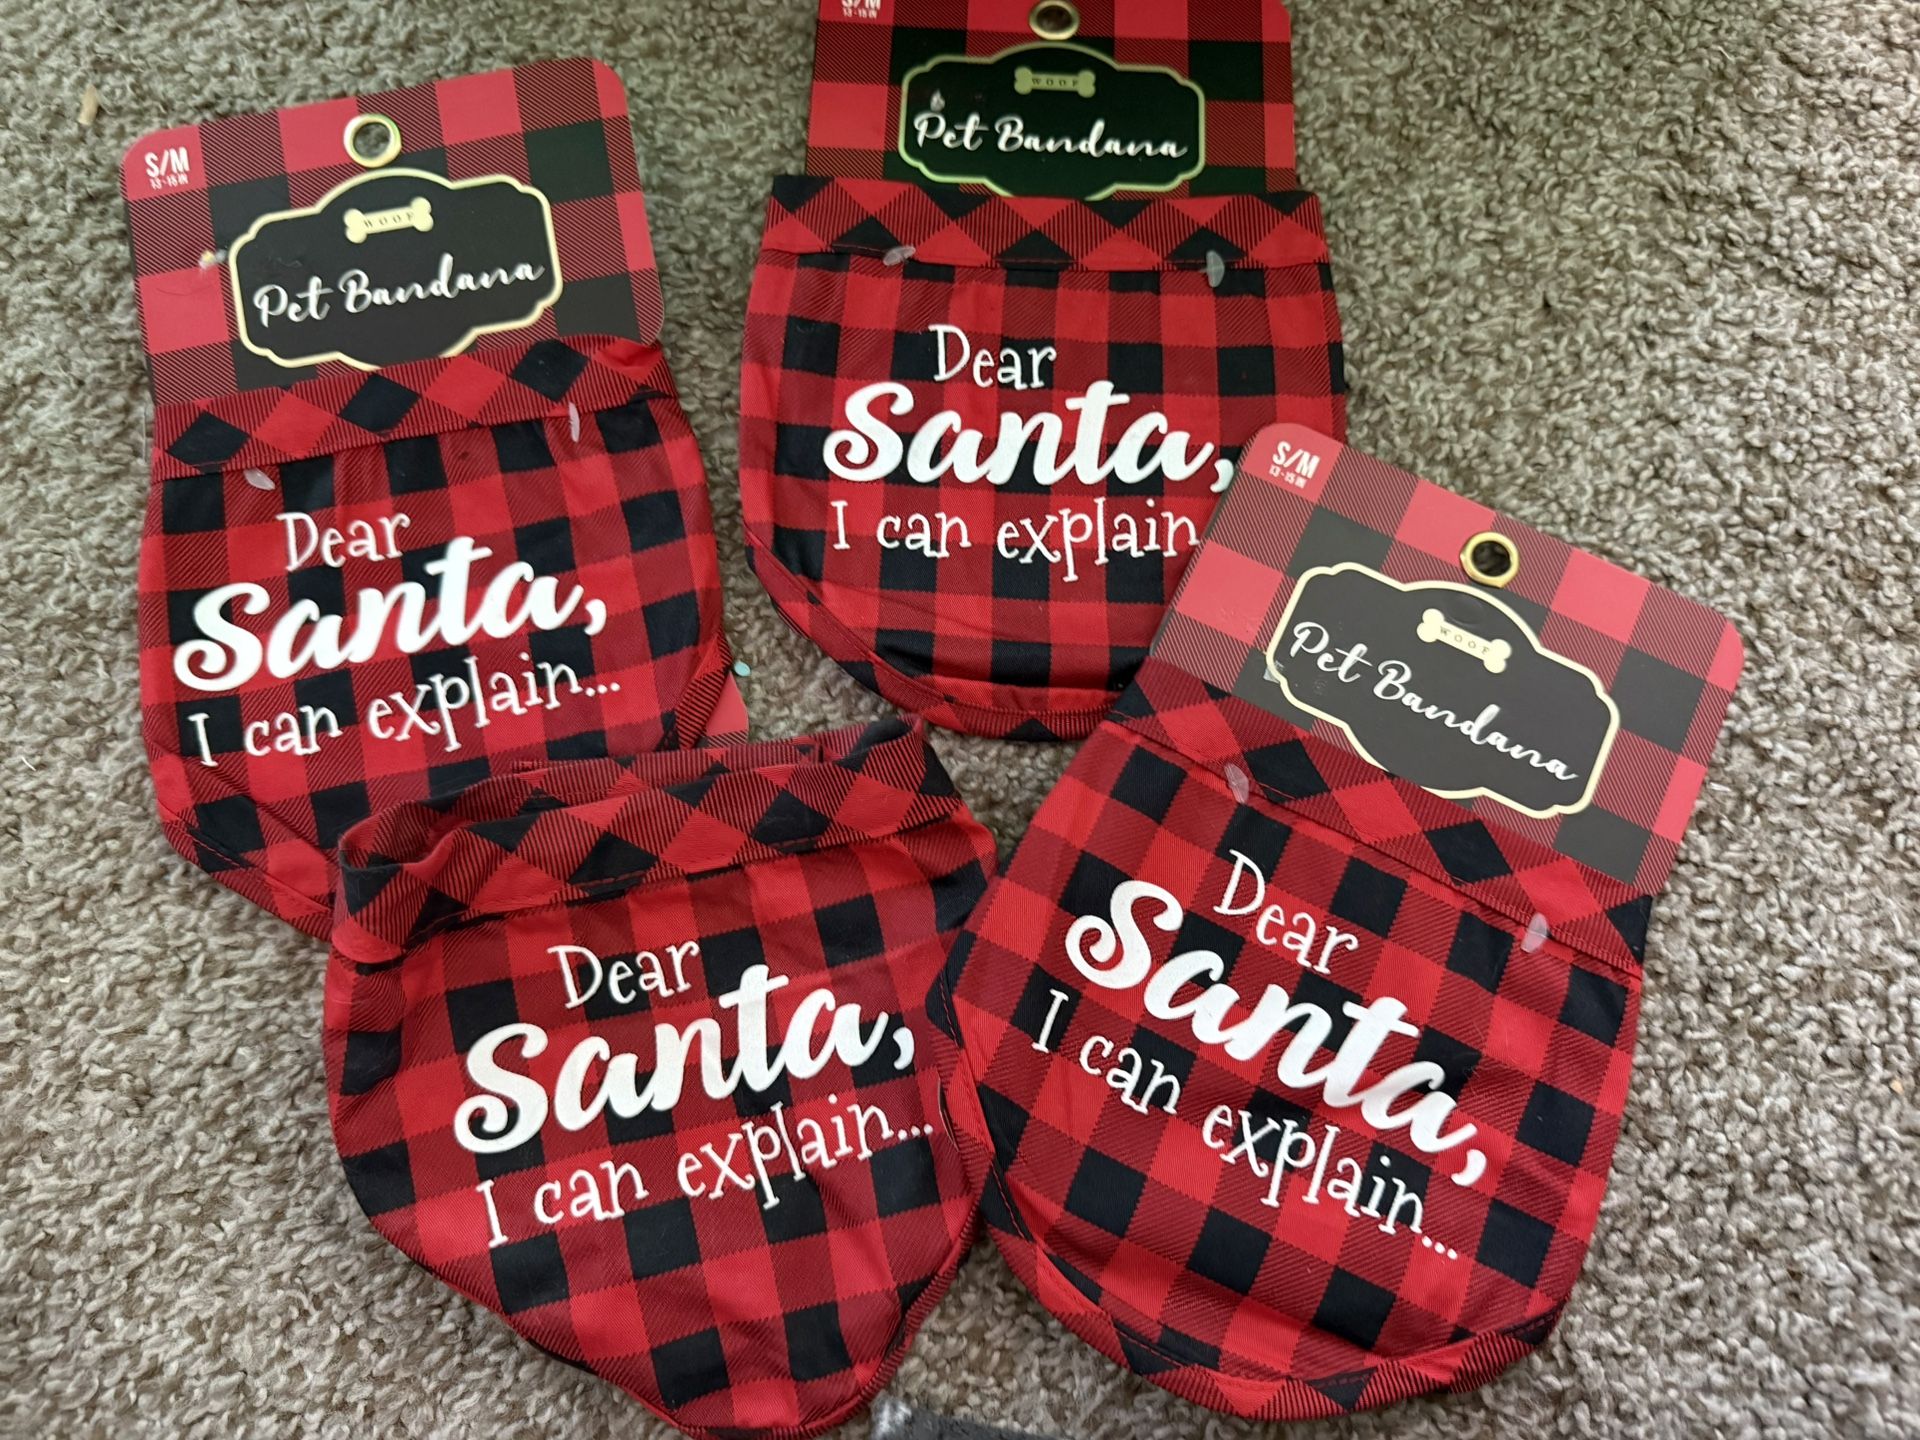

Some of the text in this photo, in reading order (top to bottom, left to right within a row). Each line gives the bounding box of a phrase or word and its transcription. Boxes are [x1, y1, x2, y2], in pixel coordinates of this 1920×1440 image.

[1031, 78, 1079, 88] WOOF
[144, 146, 190, 178] S/M
[913, 112, 1187, 158] Pet Bandana
[363, 211, 415, 229] WOOF
[252, 252, 545, 328] Pet Bandana
[928, 324, 1057, 391] Dear
[822, 380, 1234, 493] Santa,
[1272, 440, 1320, 480] S/M
[277, 513, 410, 572] Dear
[830, 500, 850, 550] I
[876, 511, 972, 559] can
[173, 536, 607, 692] Santa,
[1440, 626, 1491, 656] WOOF
[188, 654, 621, 767] I can explain...
[1292, 620, 1579, 781] Pet Bandana
[1213, 849, 1359, 974] Dear
[547, 940, 700, 1009] Dear
[453, 964, 915, 1154] Santa,
[1064, 880, 1487, 1187] Santa,
[1031, 988, 1458, 1260] I can explain...
[475, 1093, 933, 1249] I can explain...
